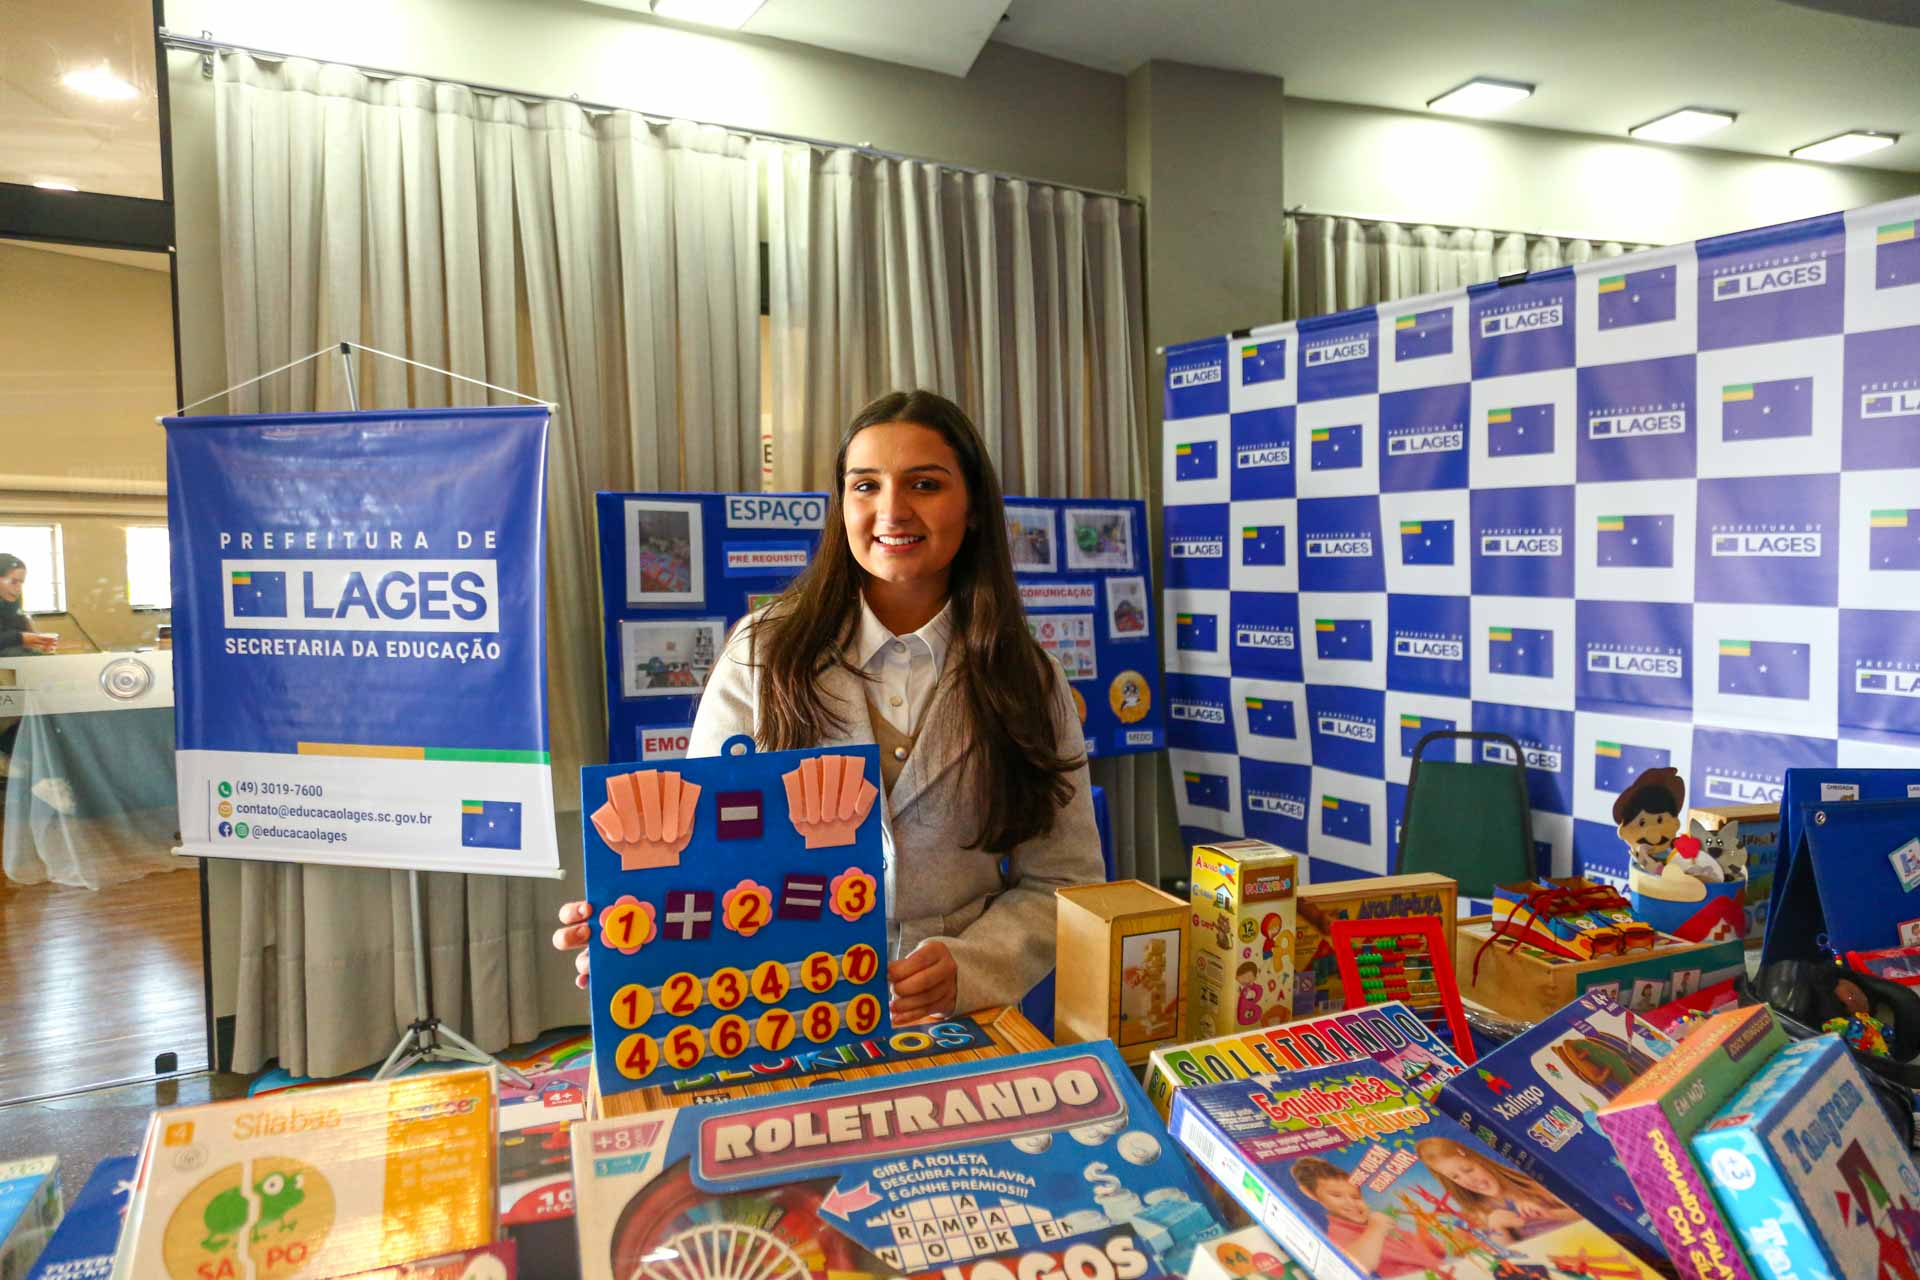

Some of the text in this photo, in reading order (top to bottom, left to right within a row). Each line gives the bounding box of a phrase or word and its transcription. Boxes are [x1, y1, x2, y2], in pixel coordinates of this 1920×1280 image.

[1713, 255, 1800, 277] PREFEITURA
[1746, 265, 1822, 292] LAGES
[1505, 309, 1560, 330] LAGES
[1324, 343, 1367, 361] LAGES
[1185, 369, 1220, 384] LAGES
[1588, 403, 1663, 417] PREFEITURA
[1616, 415, 1682, 434] LAGES
[1410, 434, 1461, 451] LAGES
[1252, 450, 1288, 465] LAGES
[730, 499, 822, 526] ESPAÇO
[1712, 524, 1796, 533] PREFEITURA
[220, 530, 497, 550] PREFEITURA DE
[1187, 544, 1221, 556] LAGES
[1325, 542, 1369, 555] LAGES
[1505, 538, 1559, 553] LAGES
[1744, 537, 1817, 553] LAGES
[302, 570, 488, 621] LAGES
[1252, 632, 1292, 647] LAGES
[224, 637, 501, 664] SECRETARIA DA EDUCAÇÃO
[1413, 642, 1461, 658] LAGES
[1615, 654, 1679, 674] LAGES
[1187, 707, 1223, 723] LAGES
[1337, 721, 1375, 740] LAGES
[1505, 749, 1558, 769] LGES
[235, 781, 323, 798] (49) 3019-7600
[235, 802, 433, 826] contato@educacaolages.sc.gov.br
[1266, 798, 1303, 817] LAGES
[252, 824, 348, 844] @educacaolages
[618, 911, 635, 943] 1
[737, 893, 760, 929] 2
[845, 879, 868, 913] 3
[622, 946, 876, 1025] 1 2 3 4 5 10
[1236, 983, 1264, 1026] B
[625, 996, 876, 1076] 4 5 6 7 8 9
[1178, 1012, 1431, 1088] SOLETRANDO
[549, 1091, 573, 1101] 4+
[1250, 1075, 1402, 1128] Equilibrista
[1493, 1085, 1545, 1121] Xalingo
[232, 1106, 342, 1141] Sílabas
[713, 1069, 1100, 1162] ROLETRANDO
[1324, 1107, 1430, 1142] Maluco
[1782, 1079, 1864, 1175] Tangram
[597, 1130, 631, 1150] +8
[872, 1153, 988, 1179] GIRE A ROLETA
[1359, 1143, 1392, 1177] QUEM
[1386, 1147, 1419, 1176] CAIR!
[880, 1167, 1037, 1190] DESCUBRA A PALAVRA
[1648, 1128, 1706, 1225] FORMANDO
[899, 1181, 950, 1199] GANHE
[959, 1194, 974, 1209] A
[1667, 1205, 1697, 1247] COM
[266, 1241, 308, 1270] PO
[927, 1243, 945, 1257] O
[195, 1256, 236, 1280] SA
